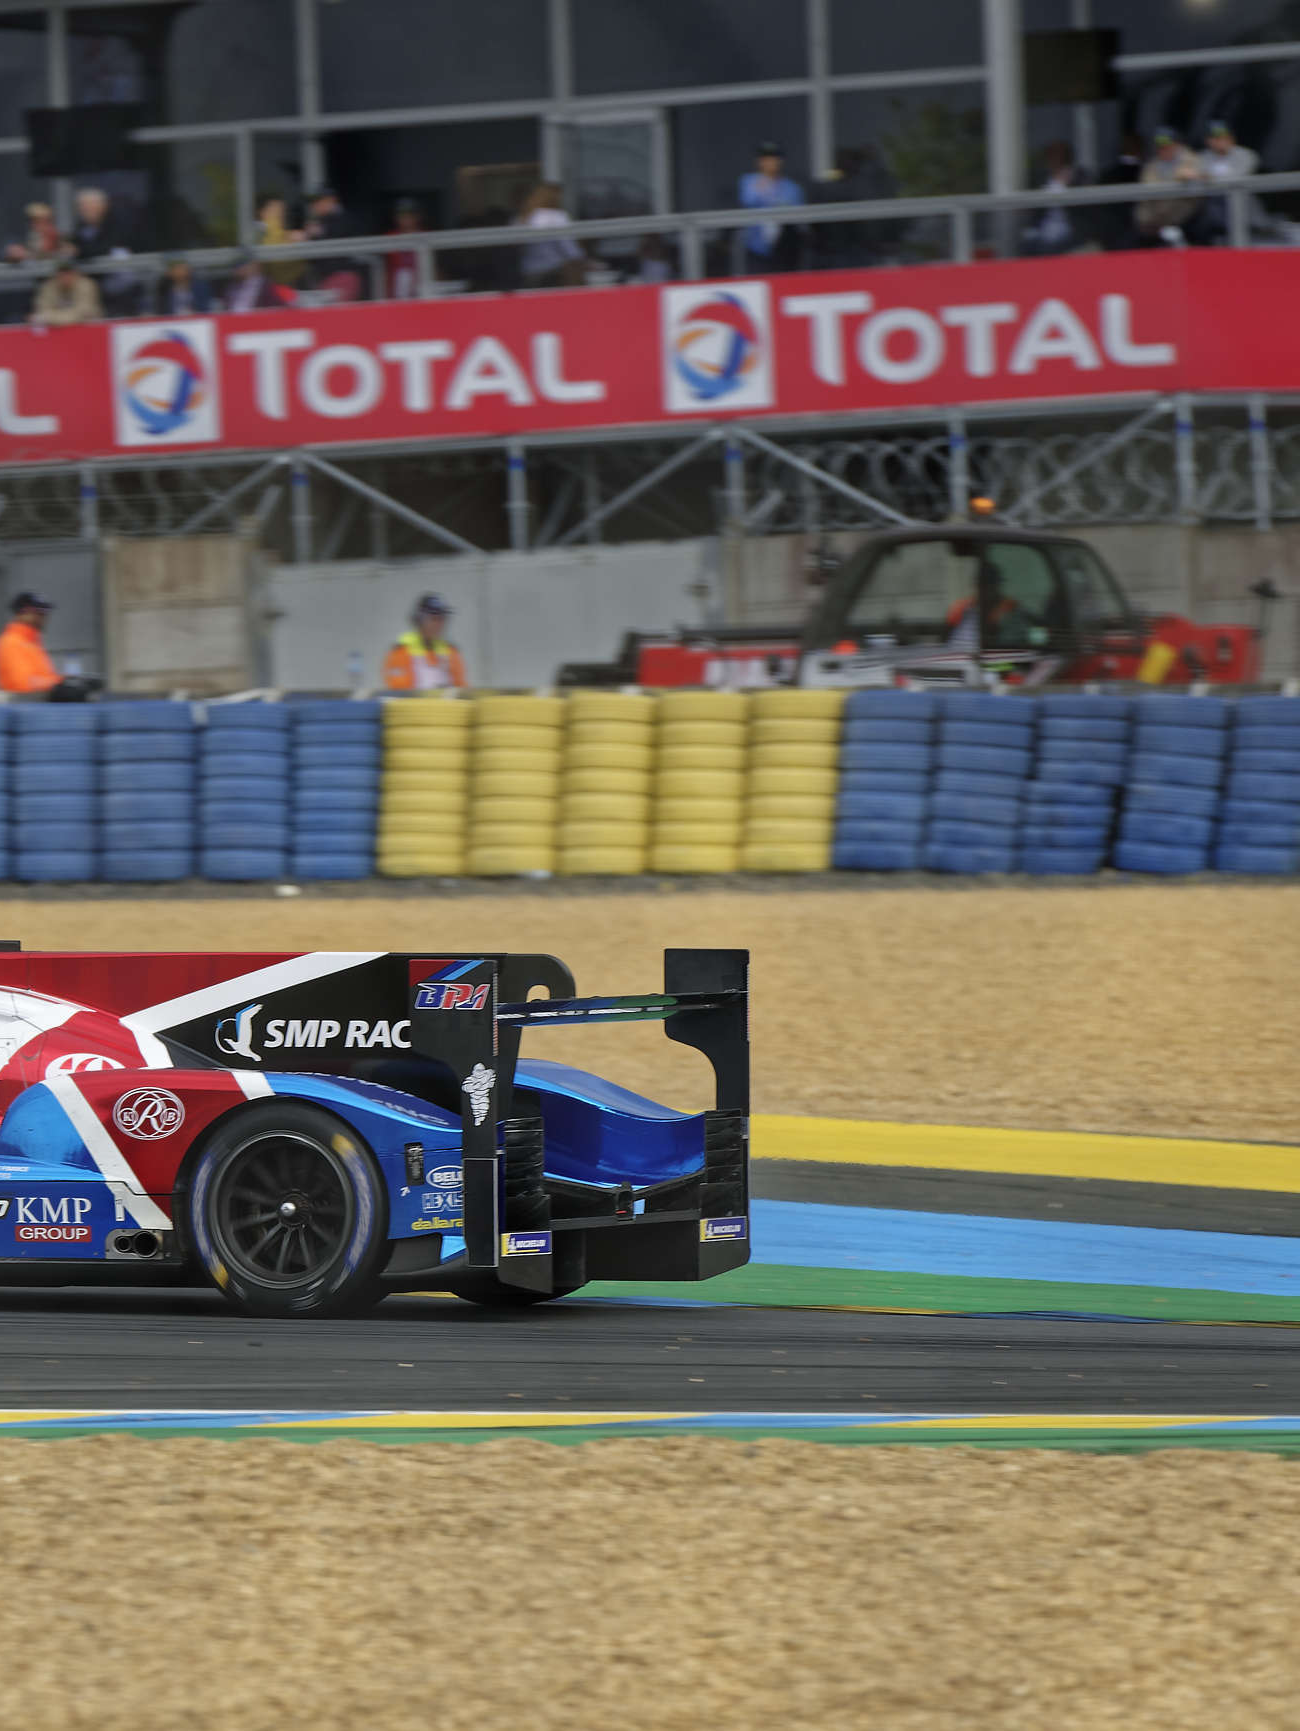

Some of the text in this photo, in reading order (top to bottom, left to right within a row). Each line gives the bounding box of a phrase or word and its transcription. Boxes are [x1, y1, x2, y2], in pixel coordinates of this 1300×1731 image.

[781, 291, 1177, 386] TOTAL
[226, 329, 606, 420] TOTAL
[263, 1019, 412, 1048] SMP RAC
[15, 1196, 92, 1224] KMP
[18, 1227, 89, 1240] GROUP
